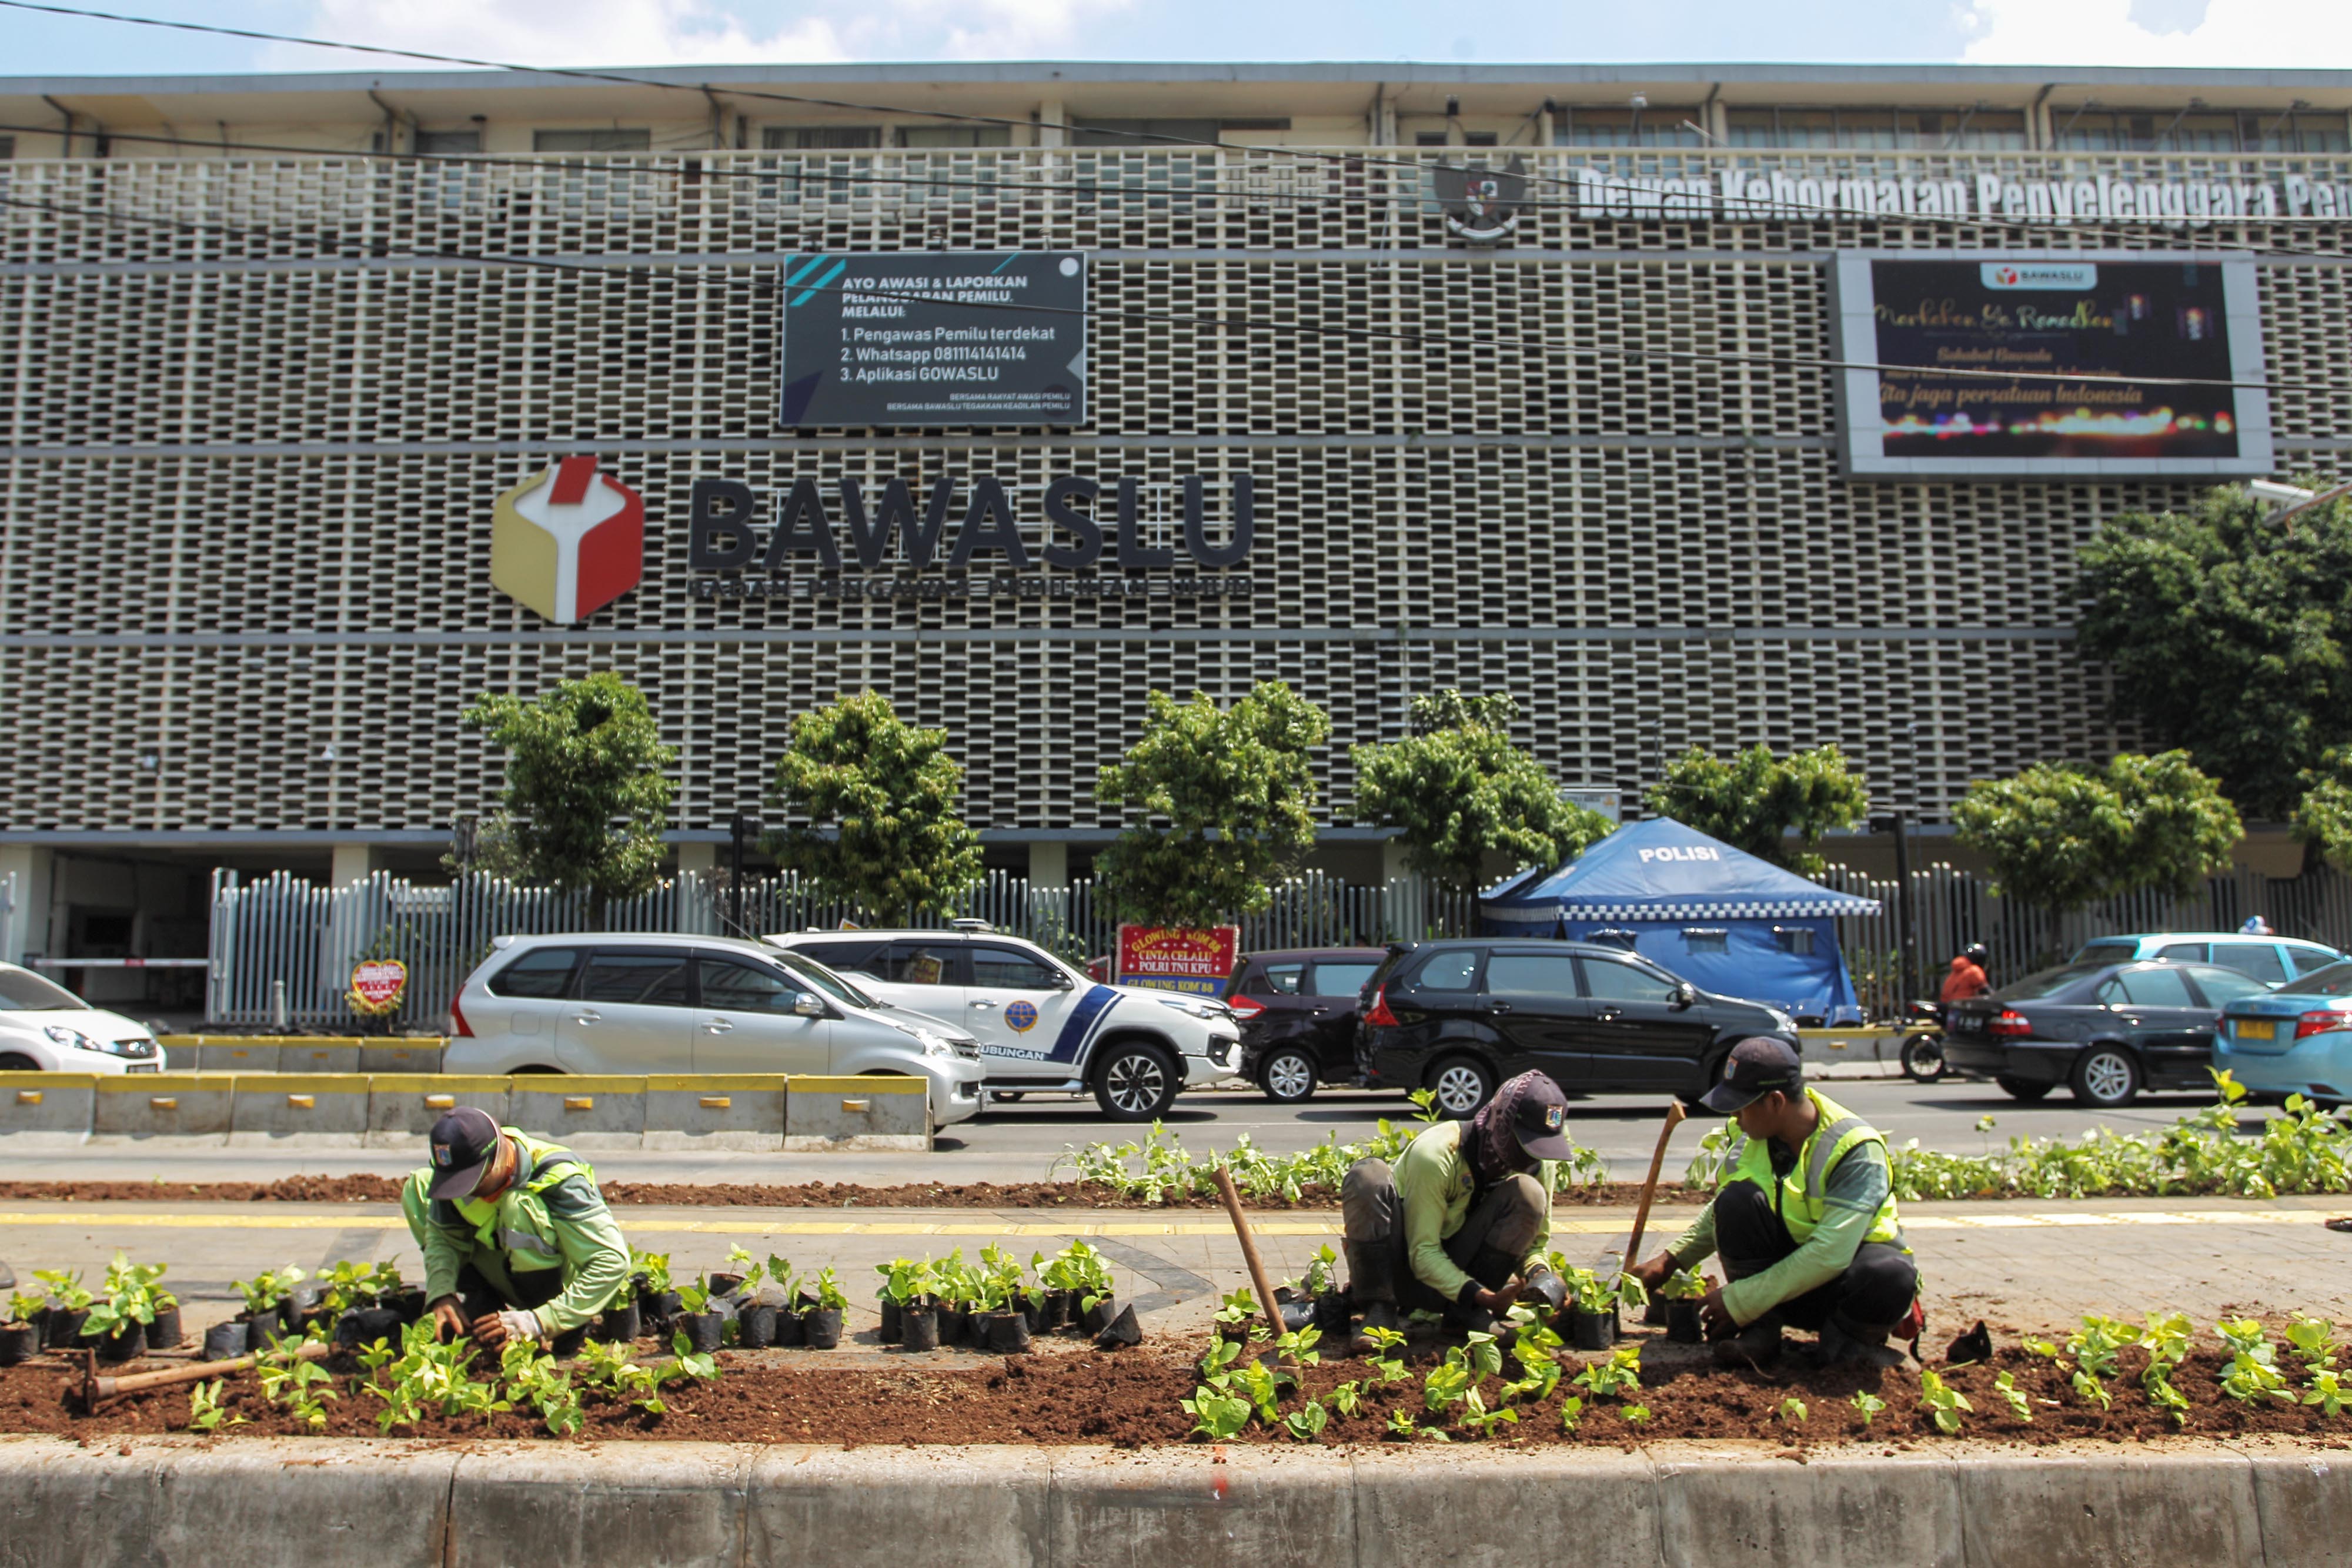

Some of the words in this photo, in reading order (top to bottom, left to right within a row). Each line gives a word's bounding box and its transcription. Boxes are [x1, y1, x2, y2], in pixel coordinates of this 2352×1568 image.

[1576, 168, 1710, 220] Dewan
[1720, 169, 1967, 221] Kehormatan
[1976, 174, 2276, 229] Penyelenggara
[842, 277, 875, 289] AYO
[878, 277, 929, 289] AWASI
[933, 278, 942, 288] &
[946, 276, 1027, 288] LAPORKAN
[2020, 270, 2083, 282] BAWASLU
[841, 327, 851, 342] 1.
[854, 327, 932, 345] Pengawas
[935, 326, 987, 341] Pemilu
[990, 326, 1055, 340] terdekat
[841, 347, 853, 362] 2.
[856, 347, 930, 364] Whatsapp
[934, 346, 1026, 362] 081114141414
[840, 367, 852, 382] 3.
[856, 367, 917, 384] Aplikasi
[919, 367, 999, 382] GOWASLU
[950, 393, 986, 401] BERSAMA
[1042, 392, 1071, 400] PEMILU
[1905, 383, 1953, 409] jaga
[1956, 382, 2053, 409] persatuan
[2056, 383, 2143, 403] Indonesia
[887, 403, 923, 411] BERSAMA
[924, 402, 961, 410] BAWASLU
[962, 402, 1001, 410] TEGAKKAN
[1003, 402, 1041, 410] KEADILAN
[1042, 402, 1070, 410] PEMILU
[689, 474, 1254, 570] BAWASLU
[1639, 845, 1719, 863] POLISI
[1131, 929, 1181, 952] GLOWING
[1138, 950, 1170, 961] CINTA
[1171, 950, 1213, 962] CELALU
[1139, 961, 1170, 972] POLRI
[1171, 961, 1188, 972] TNI
[1190, 962, 1212, 974] KPU
[1127, 979, 1176, 991] GLOWING
[981, 1045, 1044, 1061] UBUNGAN
